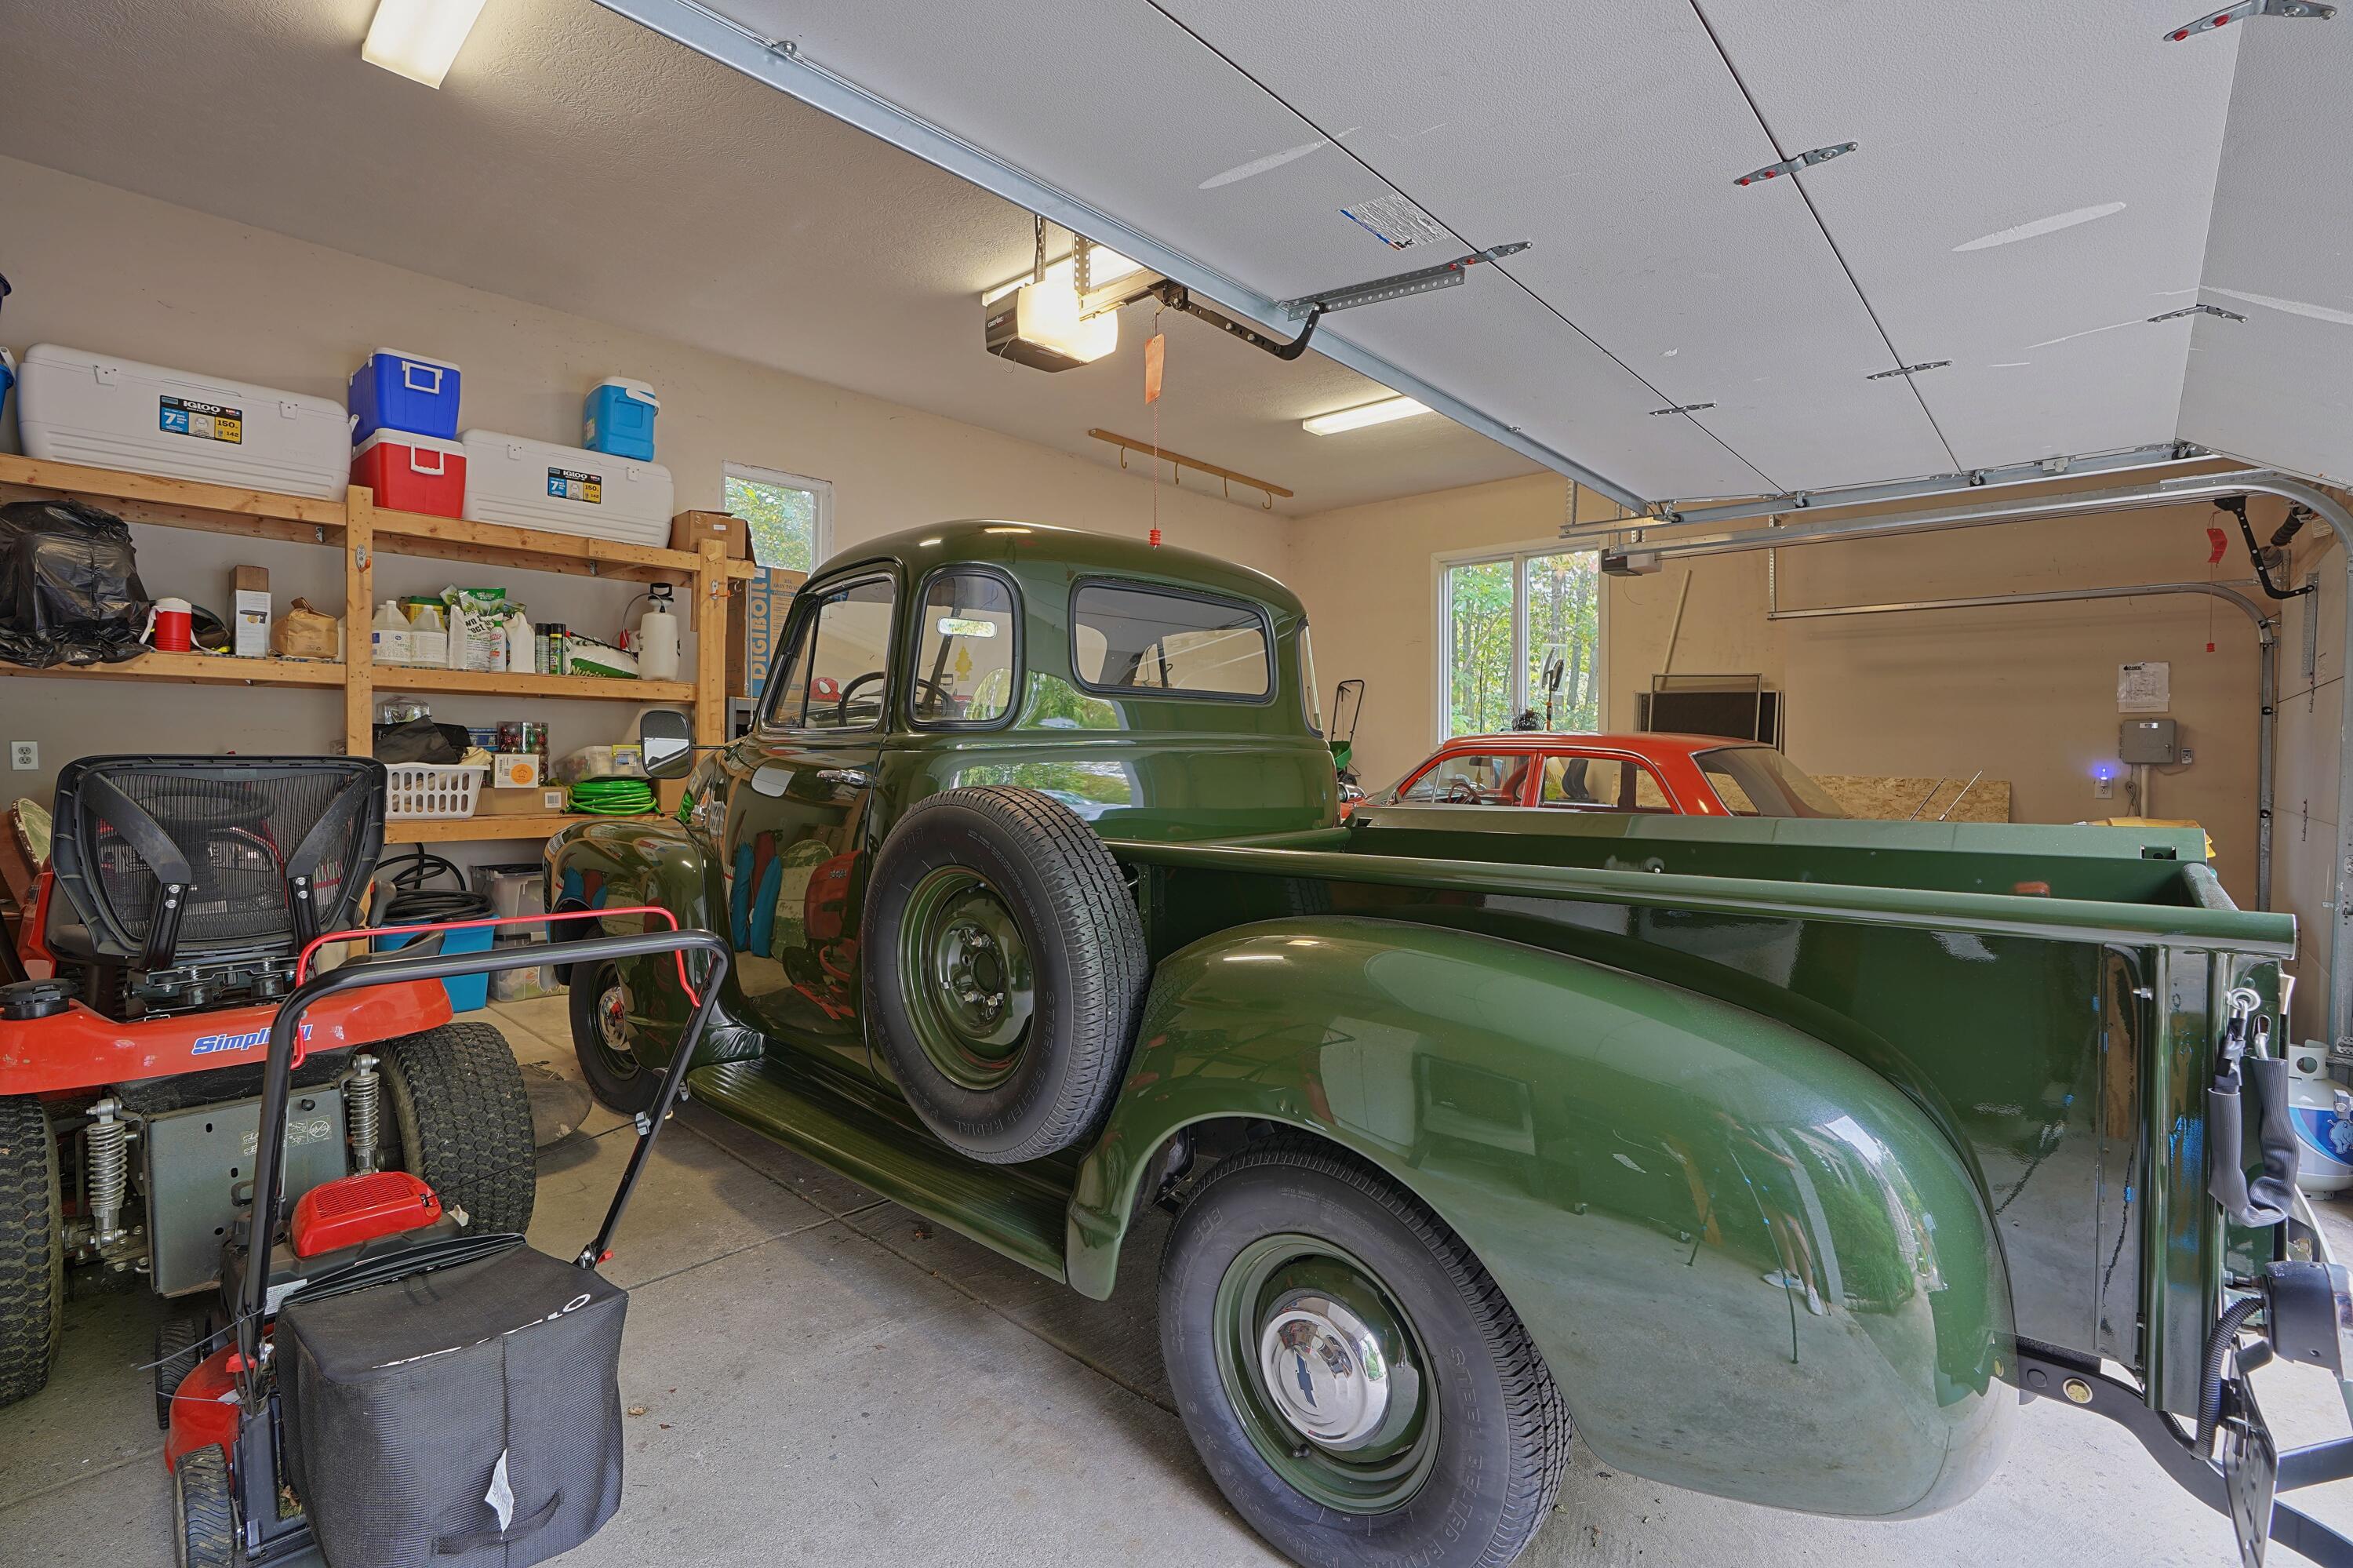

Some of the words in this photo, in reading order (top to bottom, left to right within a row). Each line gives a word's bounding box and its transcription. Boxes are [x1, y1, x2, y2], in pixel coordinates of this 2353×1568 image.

[183, 400, 220, 413] IGLOO
[164, 412, 176, 424] 7
[217, 420, 235, 428] 150
[563, 471, 587, 479] IGLOO
[551, 480, 558, 490] 7
[752, 581, 768, 680] DIGIBOIL
[1039, 991, 1055, 1065] STEEL
[1006, 1064, 1046, 1126] BELTED
[952, 1118, 1003, 1135] RADIAL
[1448, 1345, 1481, 1442] STEEL
[1441, 1450, 1482, 1544] BELTED
